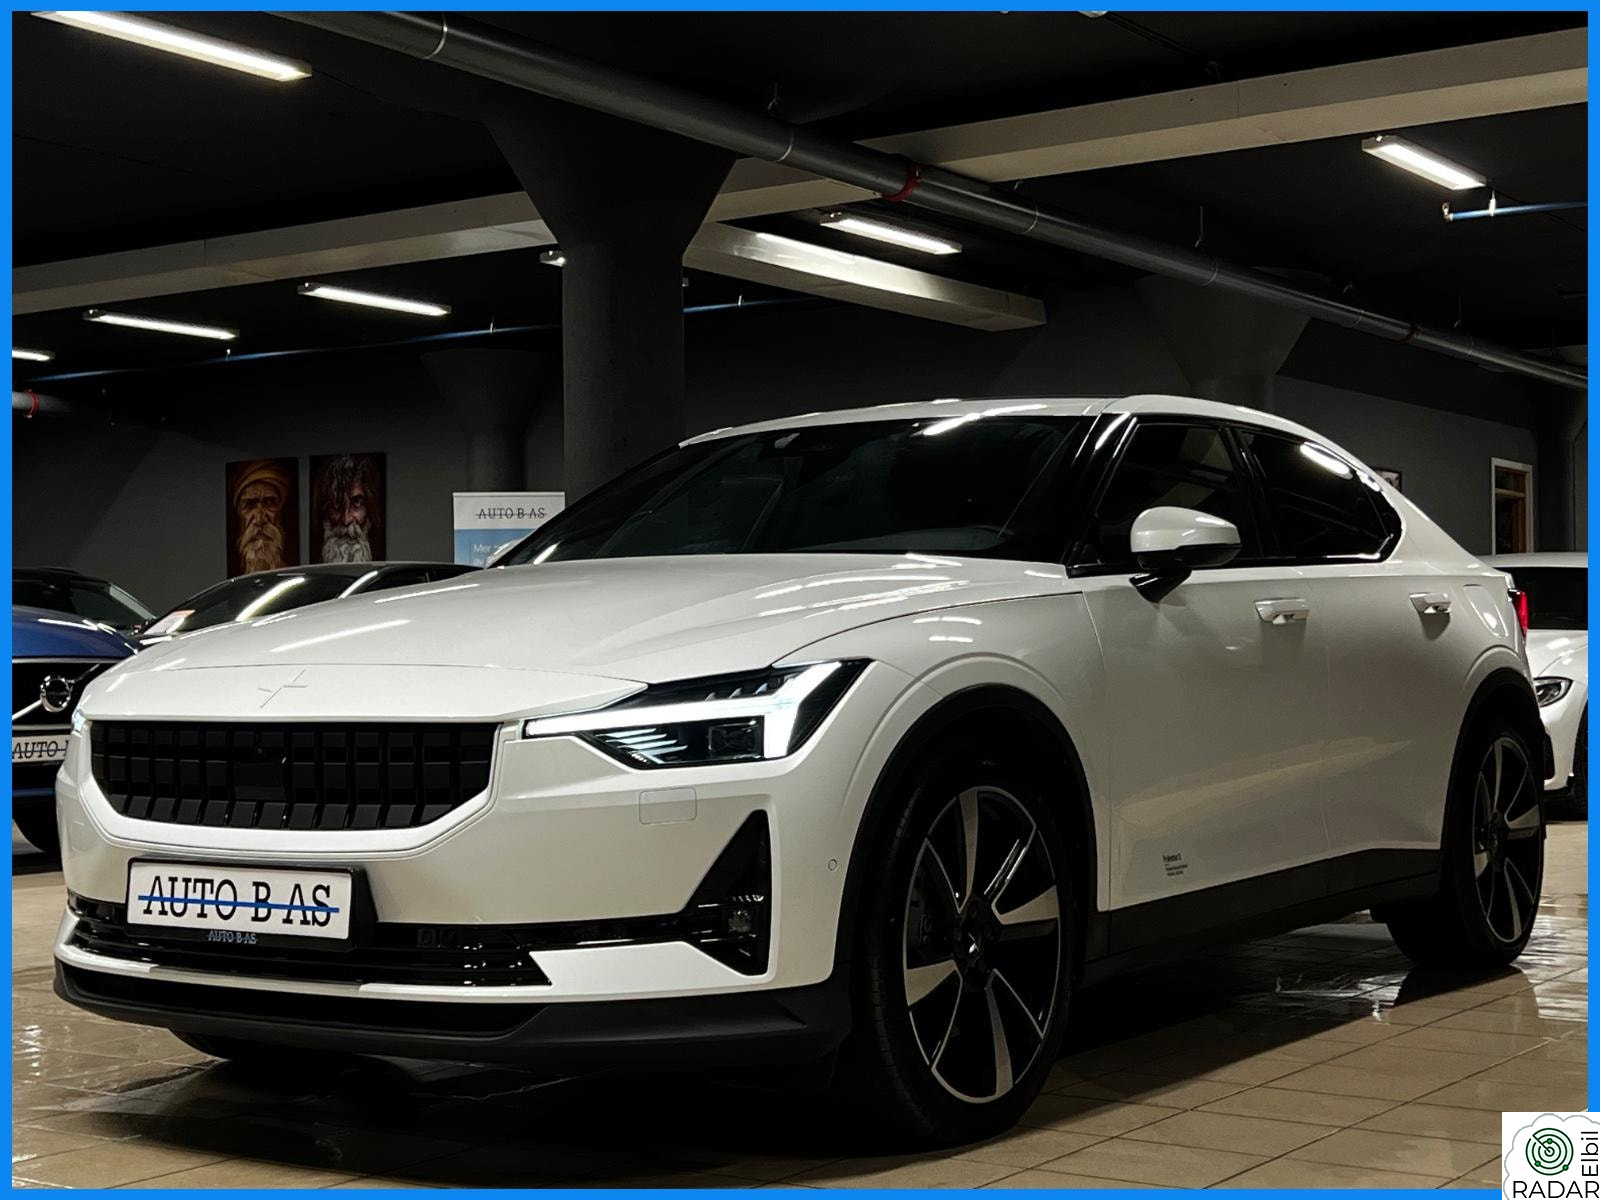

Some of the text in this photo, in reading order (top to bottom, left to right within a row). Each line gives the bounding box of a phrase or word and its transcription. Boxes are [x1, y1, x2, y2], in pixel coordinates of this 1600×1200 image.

[477, 507, 546, 520] AUTO B AS
[12, 740, 58, 760] AUTO
[143, 875, 331, 927] AUTO B AS
[208, 929, 257, 945] AUTO B AS
